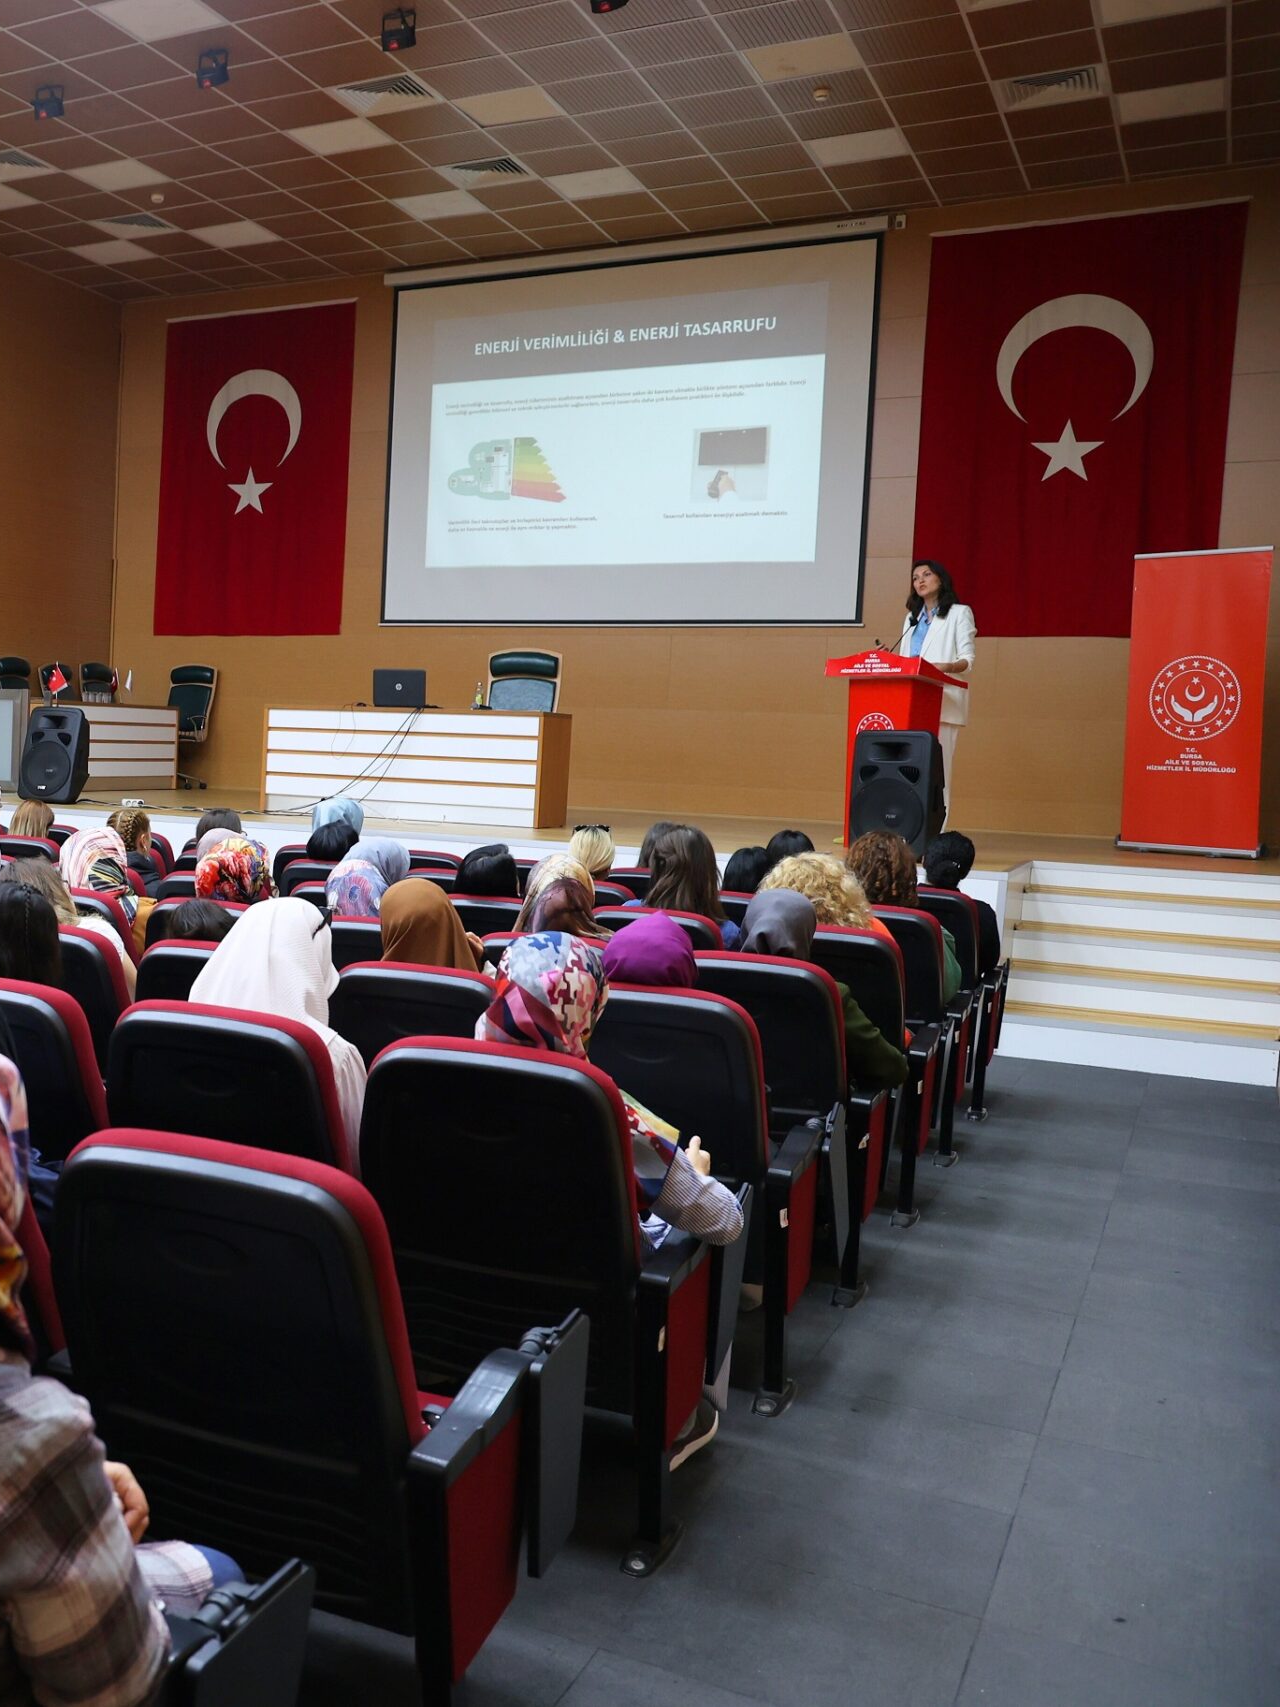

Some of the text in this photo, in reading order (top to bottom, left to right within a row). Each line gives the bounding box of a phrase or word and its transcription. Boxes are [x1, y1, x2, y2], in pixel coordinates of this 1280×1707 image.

[474, 316, 777, 356] ENERJİ VERİMLİLİĞİ & ENERJİ TASARRUFU
